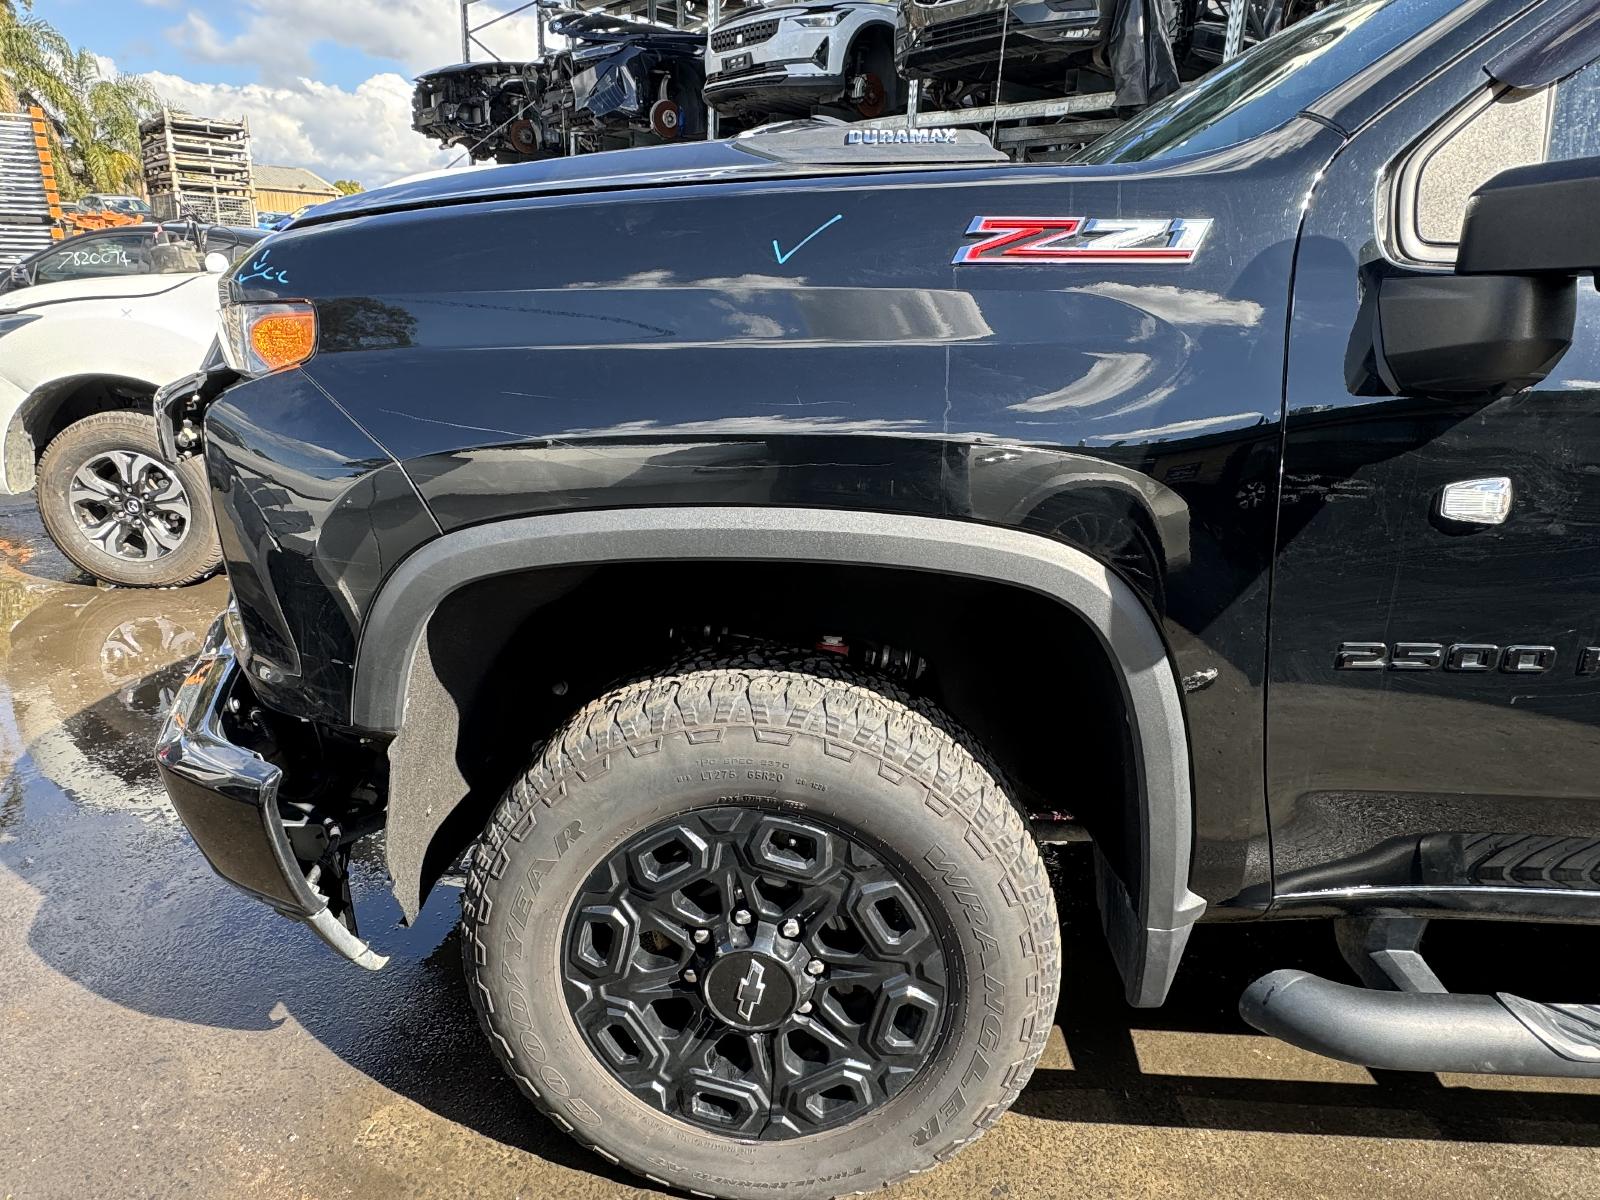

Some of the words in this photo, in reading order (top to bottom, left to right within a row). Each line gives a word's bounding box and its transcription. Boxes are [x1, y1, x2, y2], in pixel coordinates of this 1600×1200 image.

[844, 127, 958, 146] DURAMAX
[951, 215, 1214, 266] Z71
[1335, 641, 1557, 673] 2500
[502, 818, 602, 1126] GOODYEAR
[911, 842, 1006, 1148] WRANGLER
